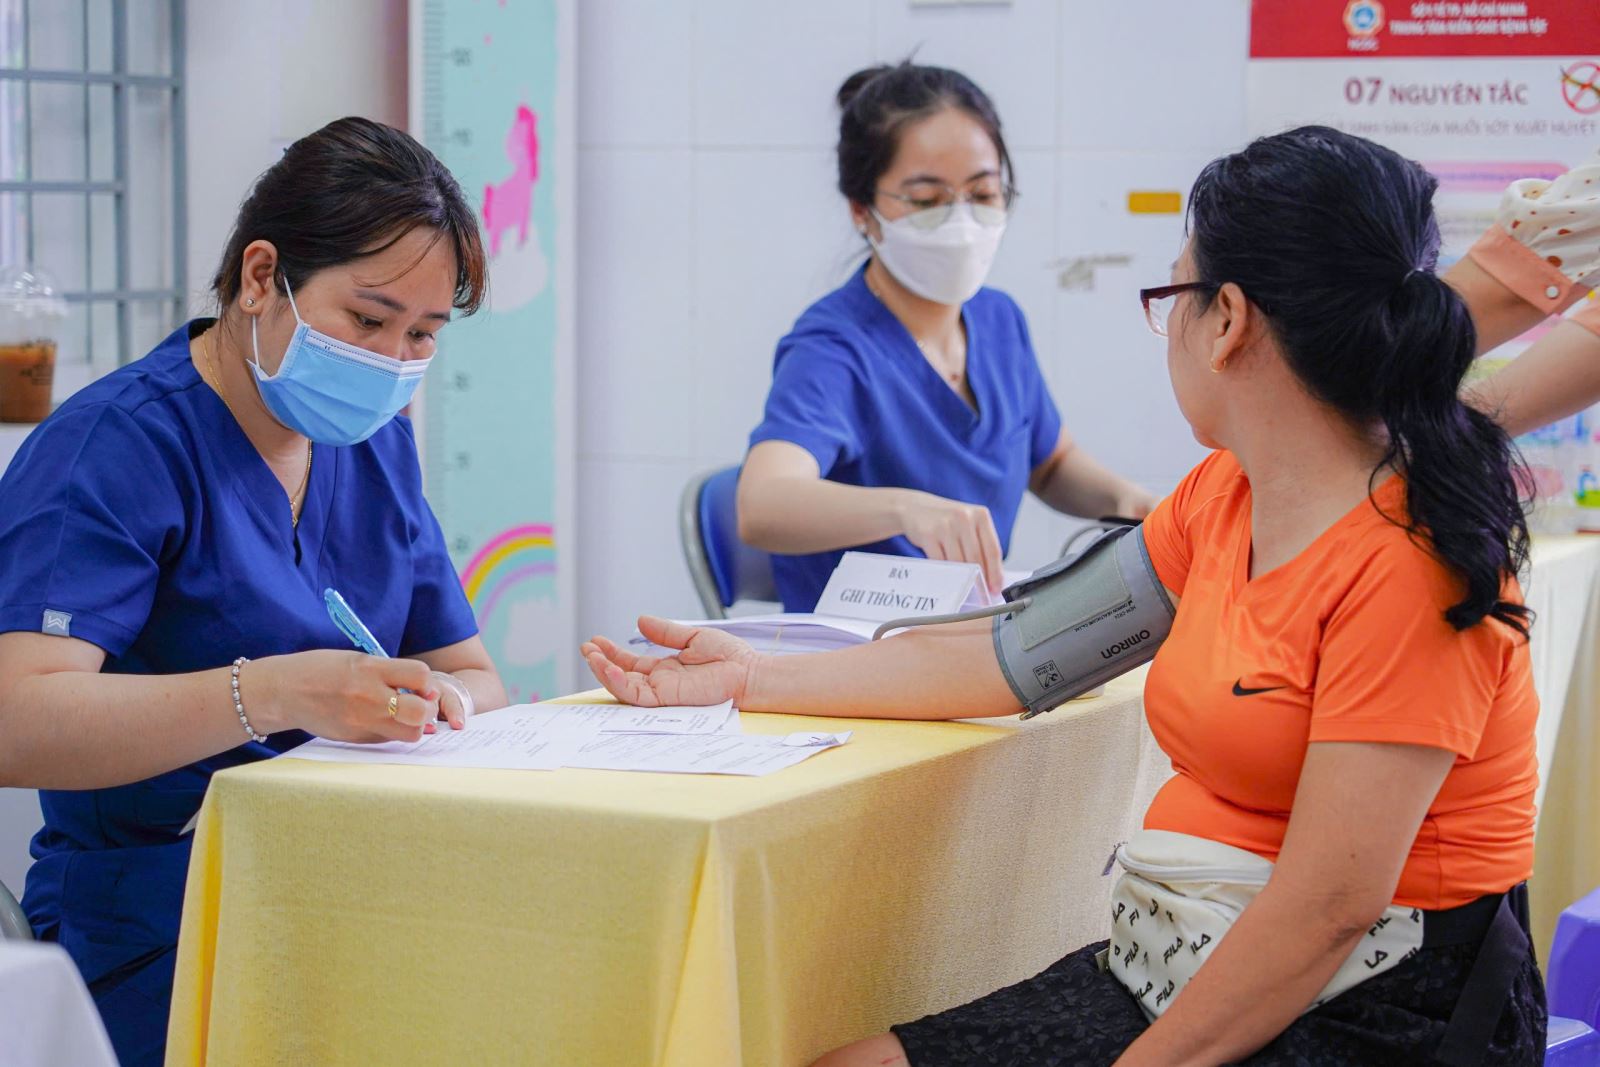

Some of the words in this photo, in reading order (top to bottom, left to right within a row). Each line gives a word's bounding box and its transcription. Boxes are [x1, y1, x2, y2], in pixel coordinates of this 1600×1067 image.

[1345, 77, 1382, 104] 07
[1389, 80, 1482, 105] NGUYÊN
[840, 588, 865, 603] GHI
[866, 588, 912, 609] THÔNG
[914, 595, 939, 612] TIN
[1101, 629, 1151, 659] OMRON
[1124, 941, 1139, 968] FILA
[1163, 936, 1183, 965] FILA
[1156, 979, 1175, 1007] FILA
